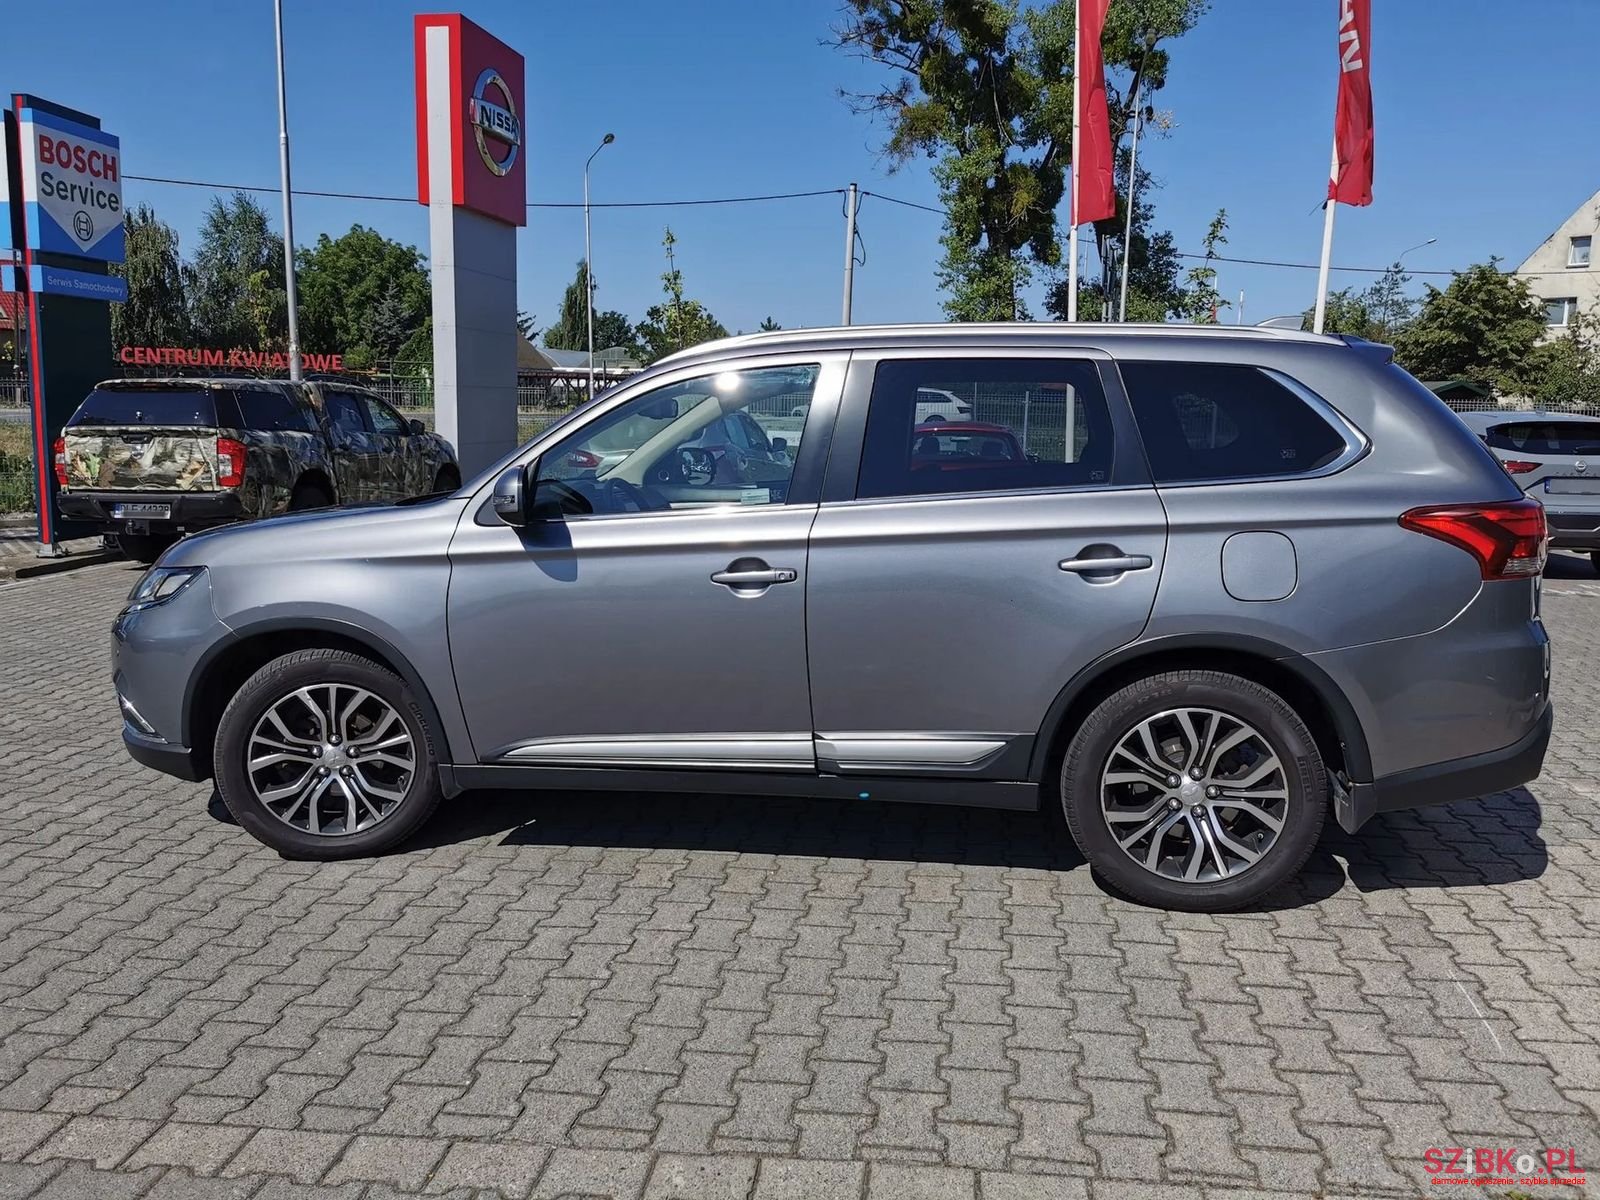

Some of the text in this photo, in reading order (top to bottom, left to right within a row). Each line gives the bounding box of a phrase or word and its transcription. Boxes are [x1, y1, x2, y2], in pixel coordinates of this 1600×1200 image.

[39, 134, 117, 182] BOSCH
[41, 171, 120, 212] Service
[47, 275, 124, 297] Serwis Samochodowy
[120, 346, 224, 366] CENTRUM
